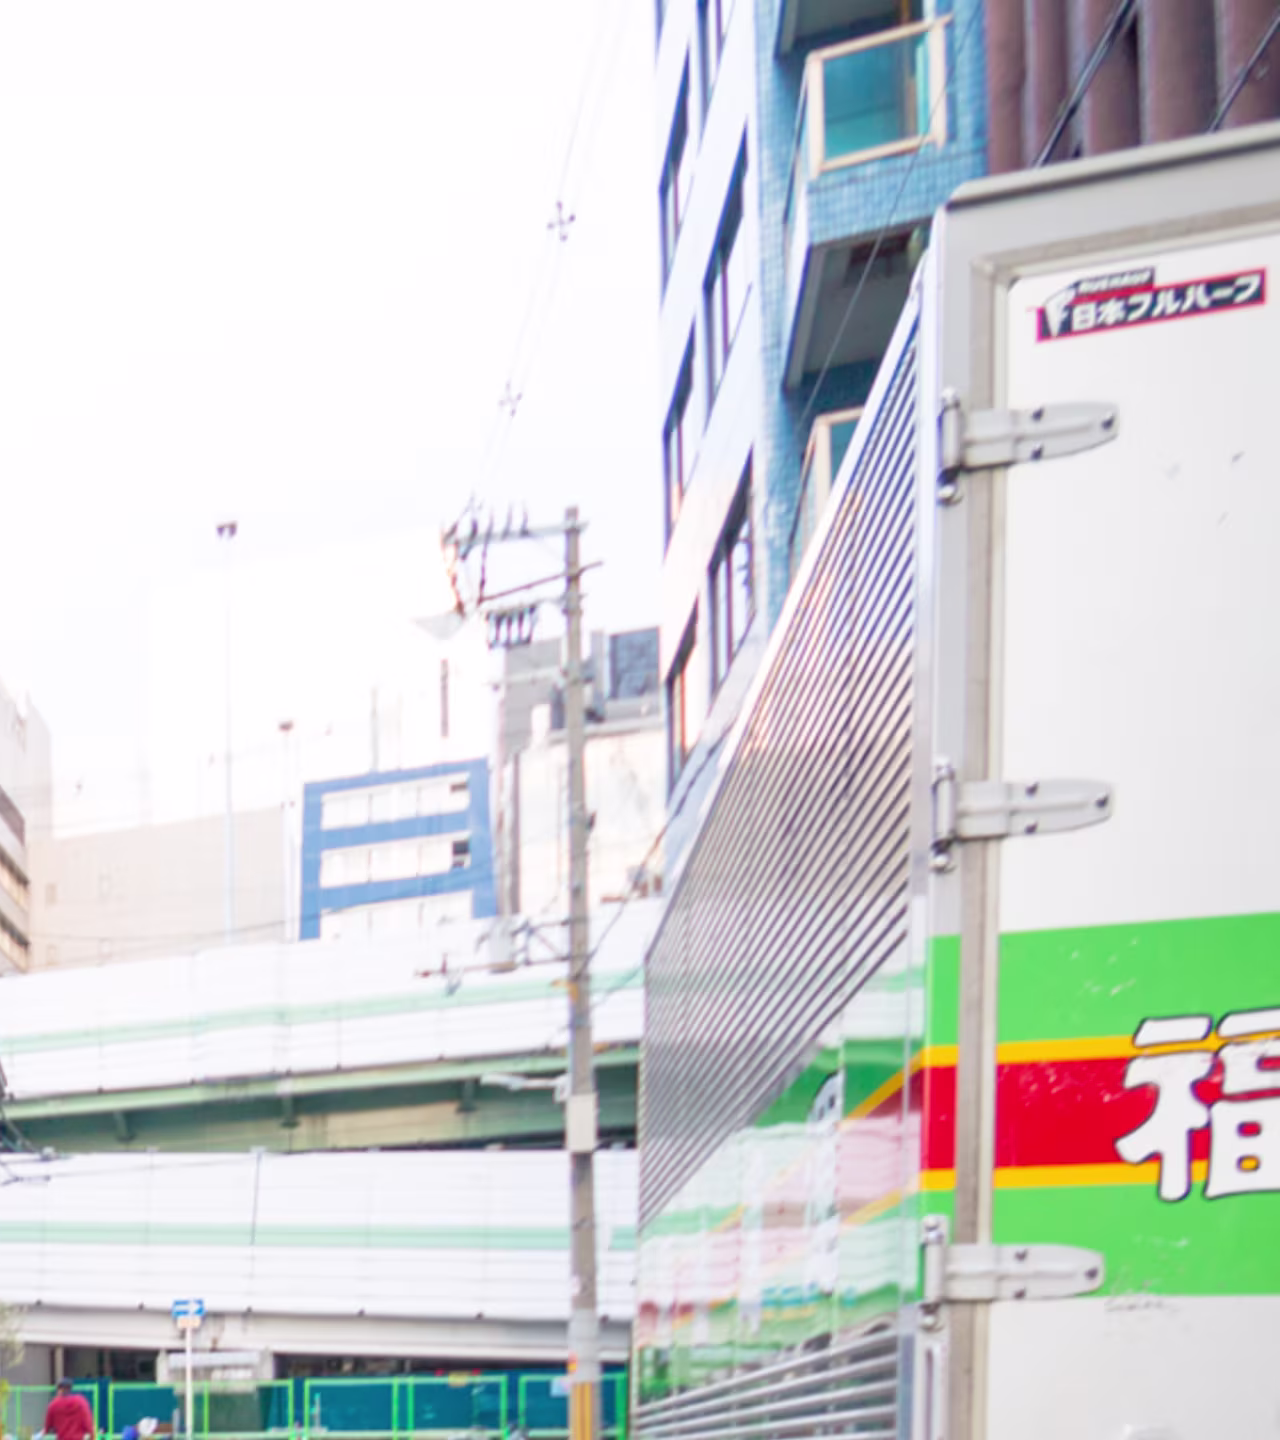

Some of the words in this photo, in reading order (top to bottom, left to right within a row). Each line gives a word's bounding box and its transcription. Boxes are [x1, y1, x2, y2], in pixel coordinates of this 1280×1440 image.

[1071, 273, 1262, 332] 日本フルハーフ
